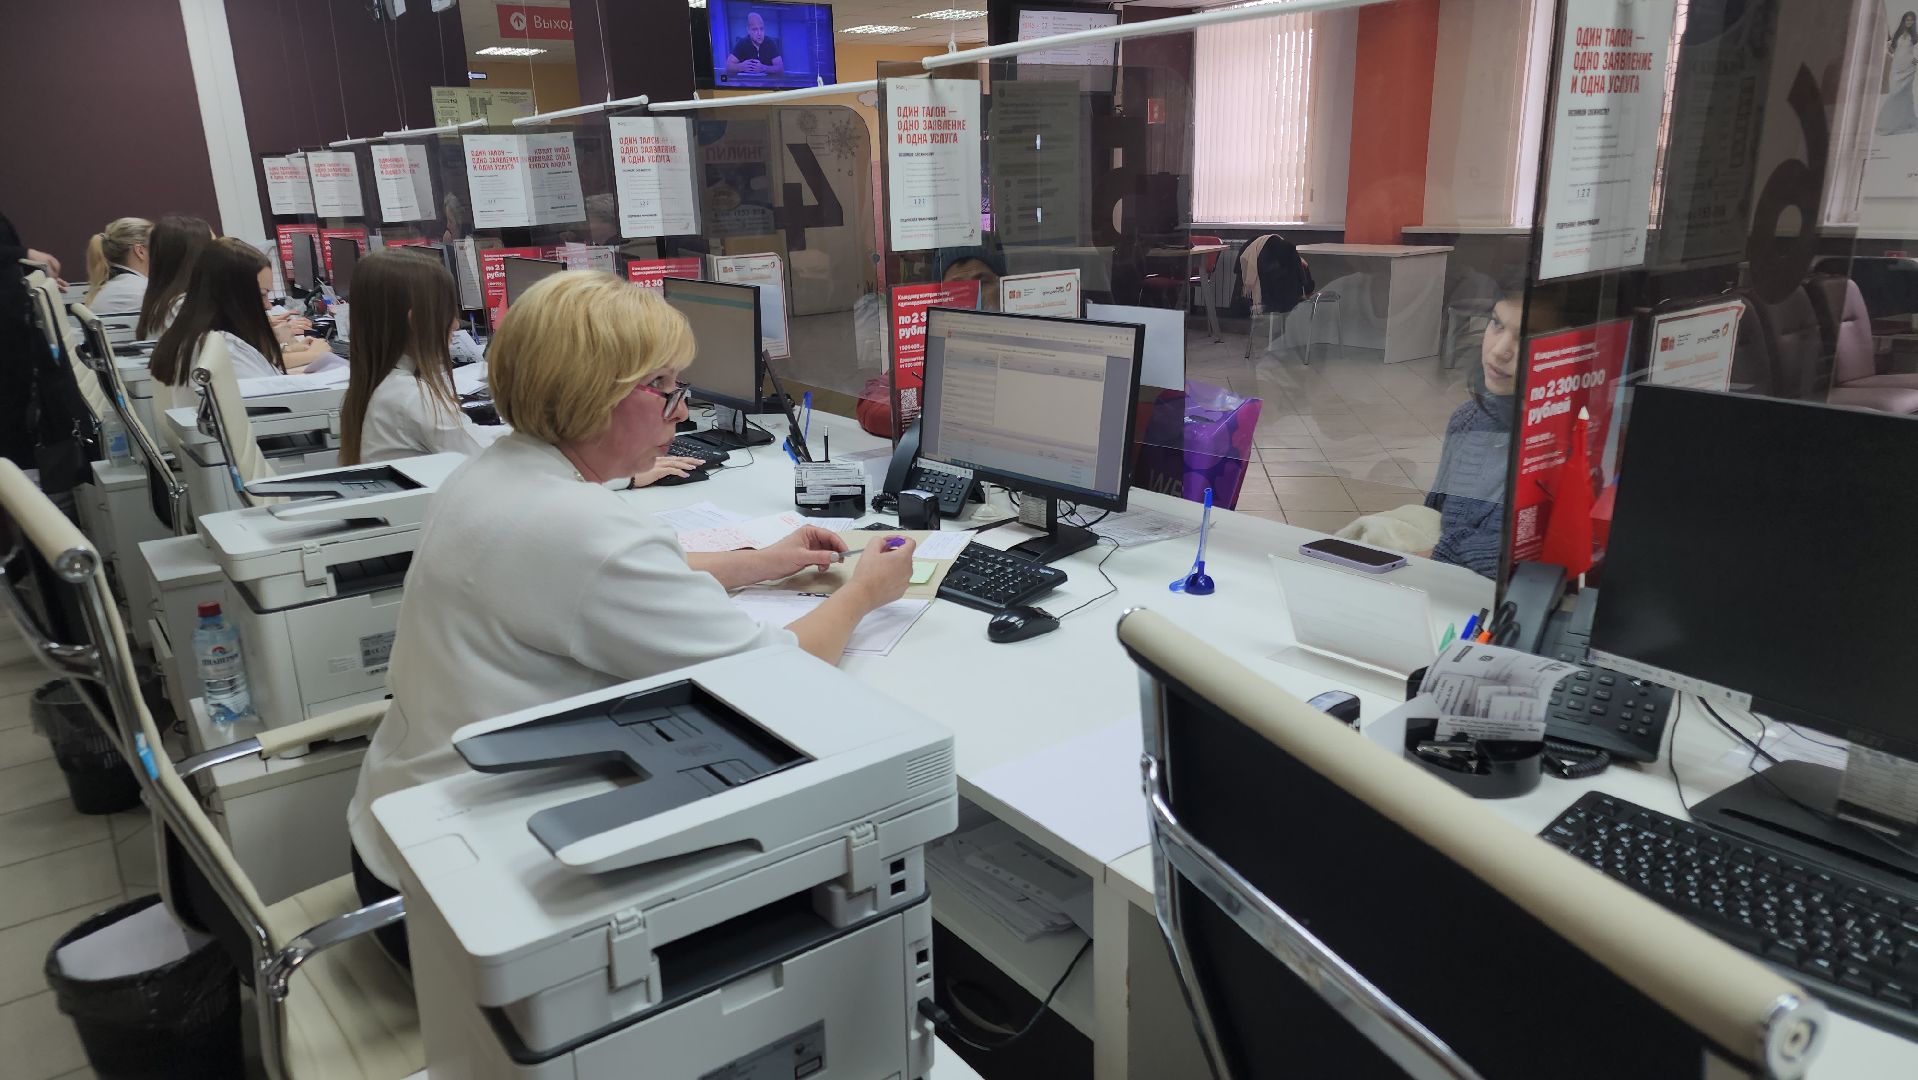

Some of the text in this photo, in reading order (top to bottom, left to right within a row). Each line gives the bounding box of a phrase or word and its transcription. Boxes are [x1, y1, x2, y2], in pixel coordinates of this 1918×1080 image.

[1576, 27, 1601, 48] ОДИН
[1605, 28, 1632, 47] ТАЛОН
[1574, 52, 1652, 72] ОДНО ЗАЯВЛЕНИЕ
[1571, 75, 1640, 96] И ОДНА УСЛУГА
[897, 106, 918, 118] ОДИН
[922, 106, 946, 117] ТАЛОН
[898, 120, 967, 132] ОДНО ЗАЯВЛЕНИЕ
[898, 133, 958, 146] И ОДНА УСЛУГА
[899, 316, 911, 324] по
[912, 312, 919, 323] 2
[1530, 369, 1606, 401] по 2 300 000
[1528, 396, 1571, 426] рублей
